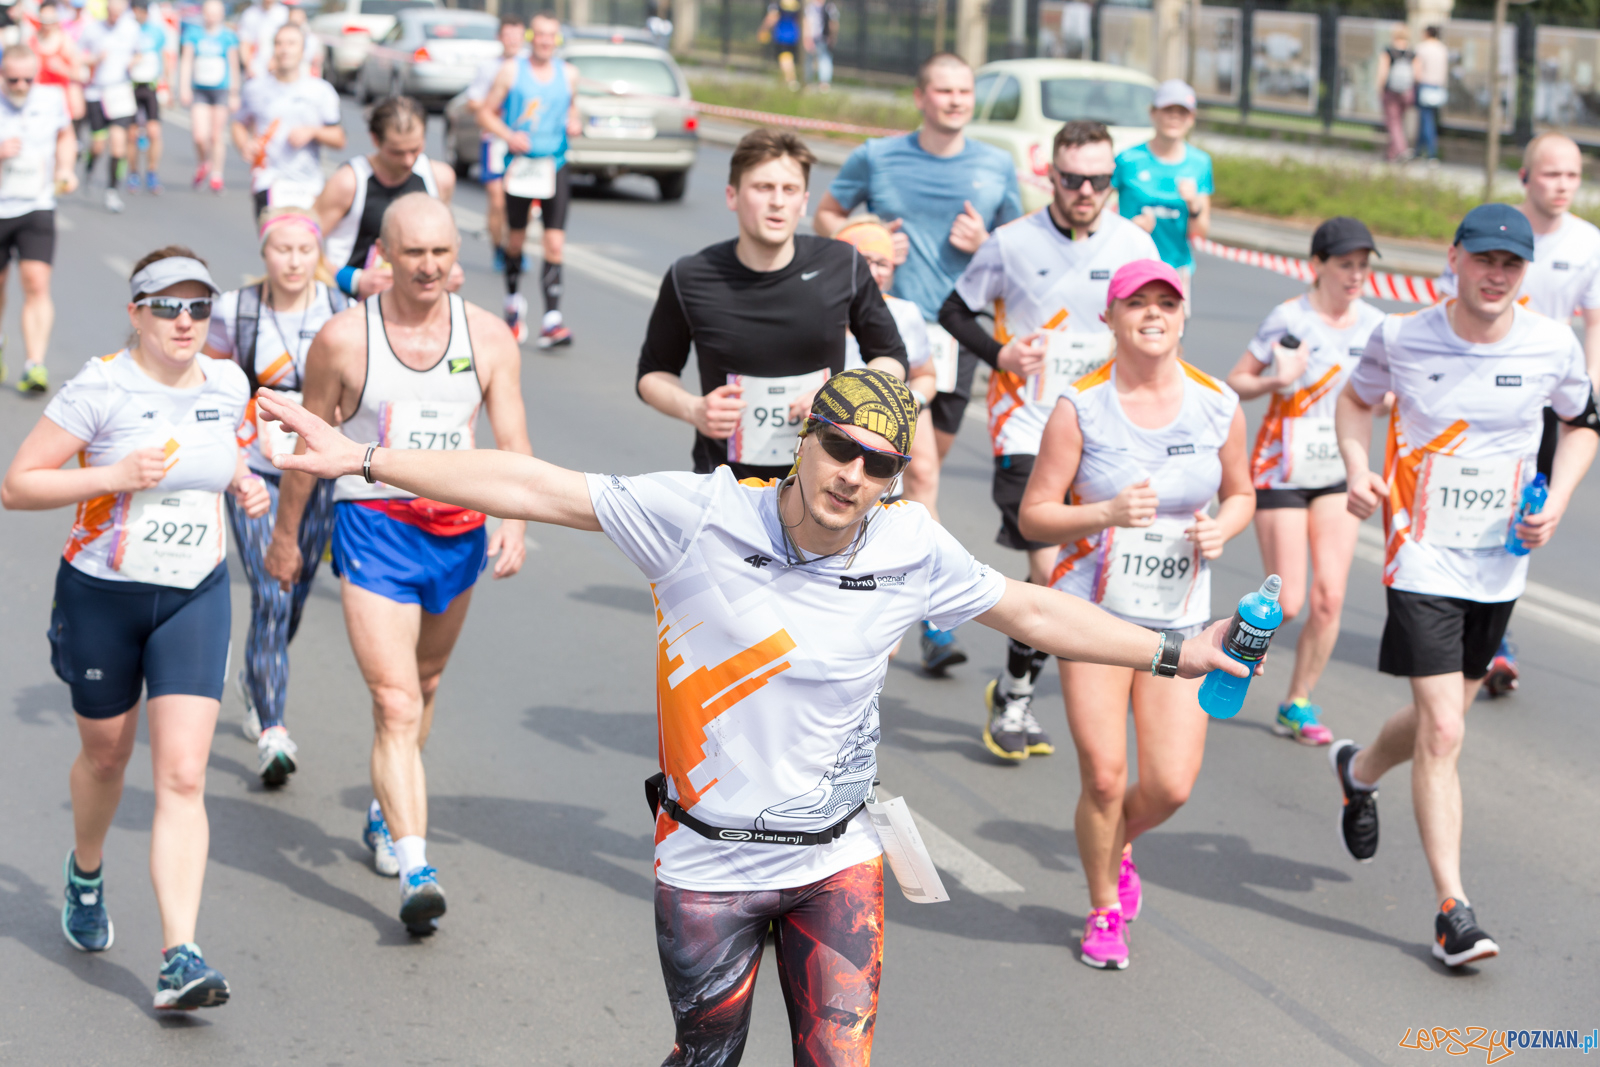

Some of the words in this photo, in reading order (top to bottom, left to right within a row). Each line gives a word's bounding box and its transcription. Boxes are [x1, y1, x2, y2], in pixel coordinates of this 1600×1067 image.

[408, 431, 462, 450] 5719
[1440, 486, 1507, 510] 11992
[143, 519, 208, 547] 2927
[744, 554, 773, 569] 4F
[1121, 553, 1190, 580] 11989
[754, 833, 804, 845] Kalenji
